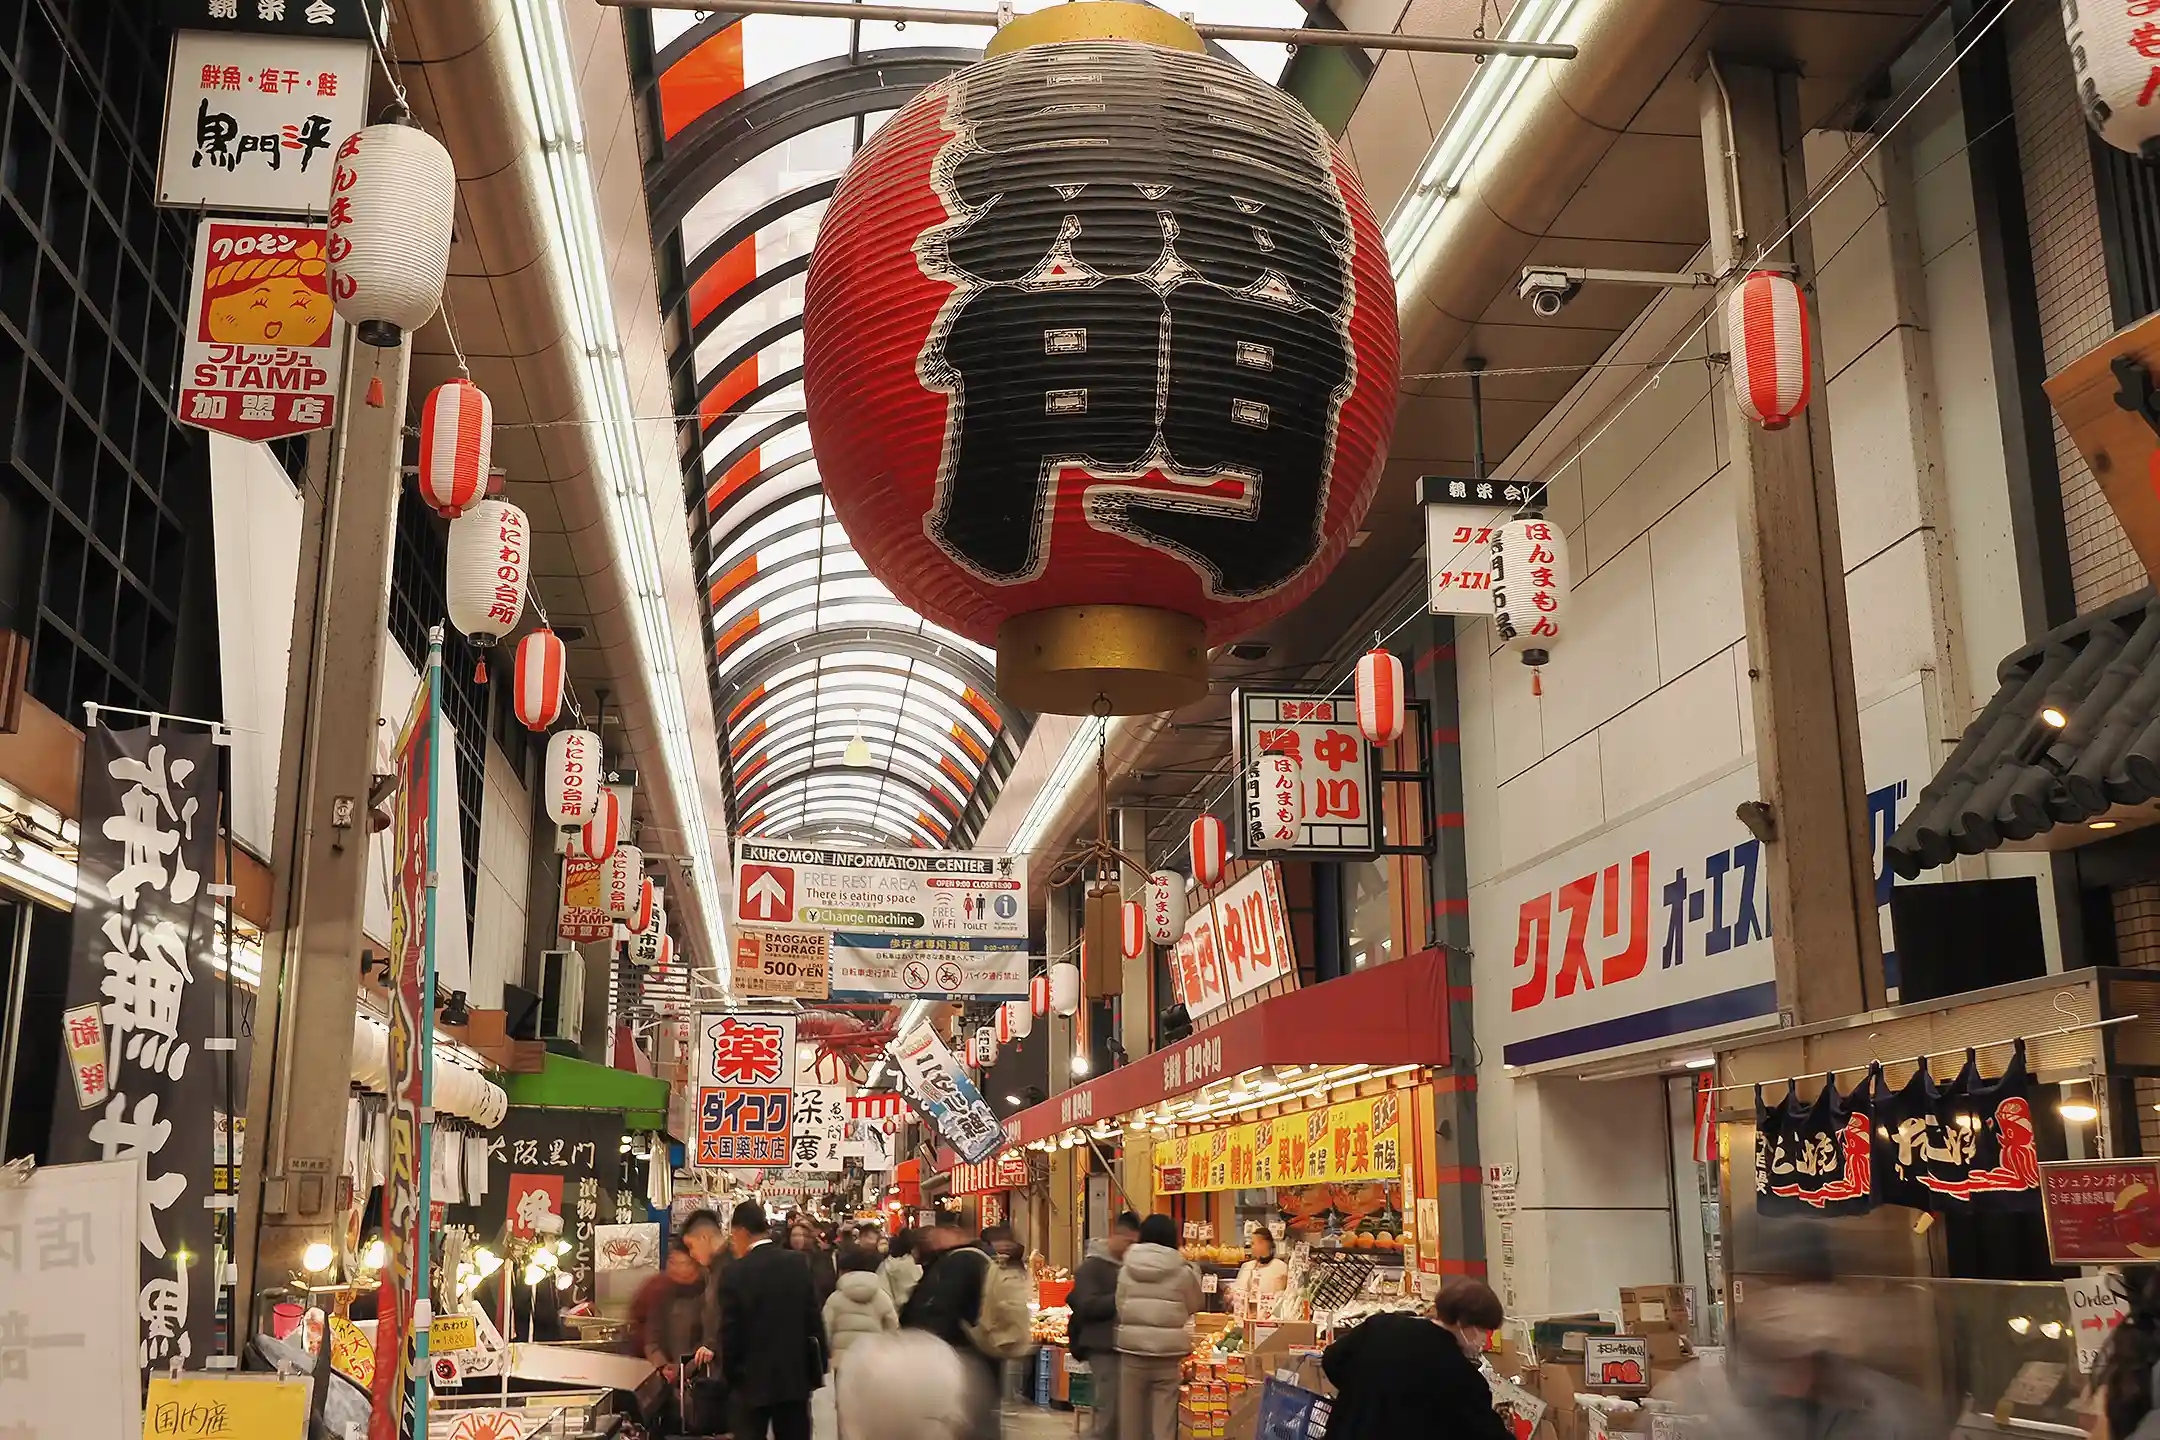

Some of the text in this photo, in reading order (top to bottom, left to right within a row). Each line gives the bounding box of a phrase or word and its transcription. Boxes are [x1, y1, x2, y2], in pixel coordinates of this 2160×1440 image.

[200, 64, 338, 97] 鮮魚・塩干・鮭
[191, 98, 332, 173] 黒門三平
[211, 233, 297, 260] クロモン
[207, 344, 313, 367] フレッシュ
[193, 364, 328, 391] STAMP
[190, 392, 326, 424] 加盟店
[1452, 526, 1494, 544] クス
[487, 507, 523, 626] なにわの台所
[1524, 522, 1560, 638] ほんまもん
[560, 734, 585, 816] なにわの台所
[1313, 729, 1361, 820] 中川
[1273, 759, 1294, 841] ほんまもん
[750, 846, 985, 873] KUROMON INFORMATION CENTER
[610, 849, 628, 912] なにわの台所
[803, 872, 919, 891] FREE REST AREA
[935, 879, 955, 888] OPEN
[956, 881, 971, 889] 9:00
[806, 887, 916, 905] There is eating space
[1153, 875, 1172, 939] ほんまもん
[562, 914, 611, 925] STAMP
[821, 910, 865, 925] Change
[866, 912, 915, 926] machine
[932, 907, 956, 918] FREE
[932, 918, 956, 929] Wi-Fi
[963, 922, 988, 931] TOILET
[764, 933, 825, 945] BAGGAGE
[1223, 889, 1272, 983] 中川
[1511, 850, 1651, 1013] クスリ
[764, 943, 825, 956] STORAGE
[763, 960, 824, 978] 500 YEN
[707, 1017, 784, 1084] 薬
[703, 1092, 789, 1133] ダイコク
[487, 1135, 596, 1170] 大阪黒門
[1308, 1148, 1328, 1177] 市場
[1334, 1121, 1370, 1175] 野菜
[1373, 1139, 1397, 1172] 市場
[2048, 1173, 2141, 1189] ミシュランガイド
[571, 1176, 600, 1304] 漬物ひとすじ
